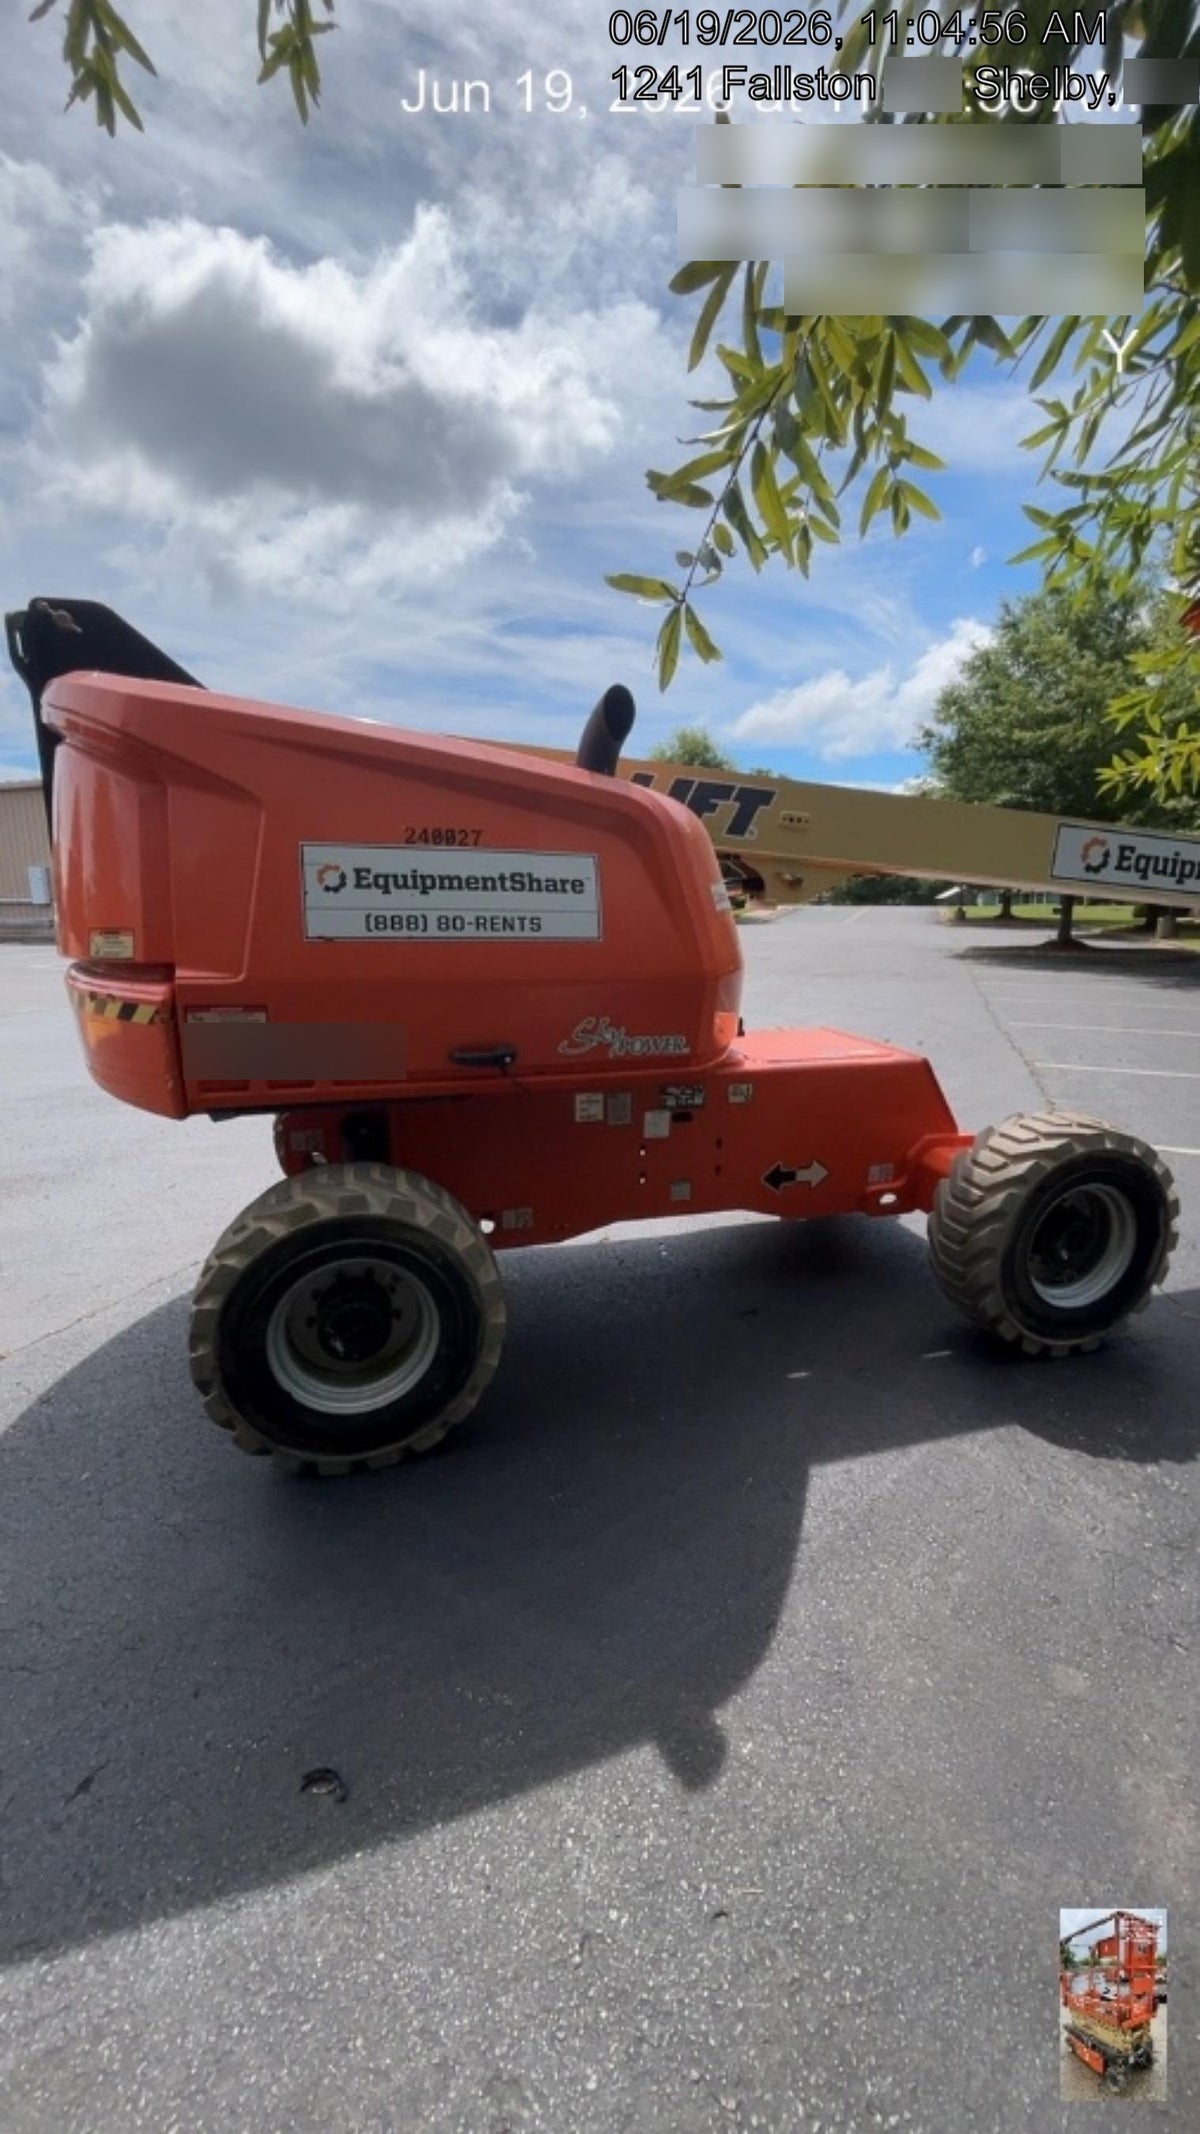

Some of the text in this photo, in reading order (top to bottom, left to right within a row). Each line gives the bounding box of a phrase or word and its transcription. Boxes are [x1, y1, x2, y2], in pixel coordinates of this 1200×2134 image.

[353, 867, 585, 894] EquipmentShare
[364, 912, 542, 933] (888) 80-RENTS
